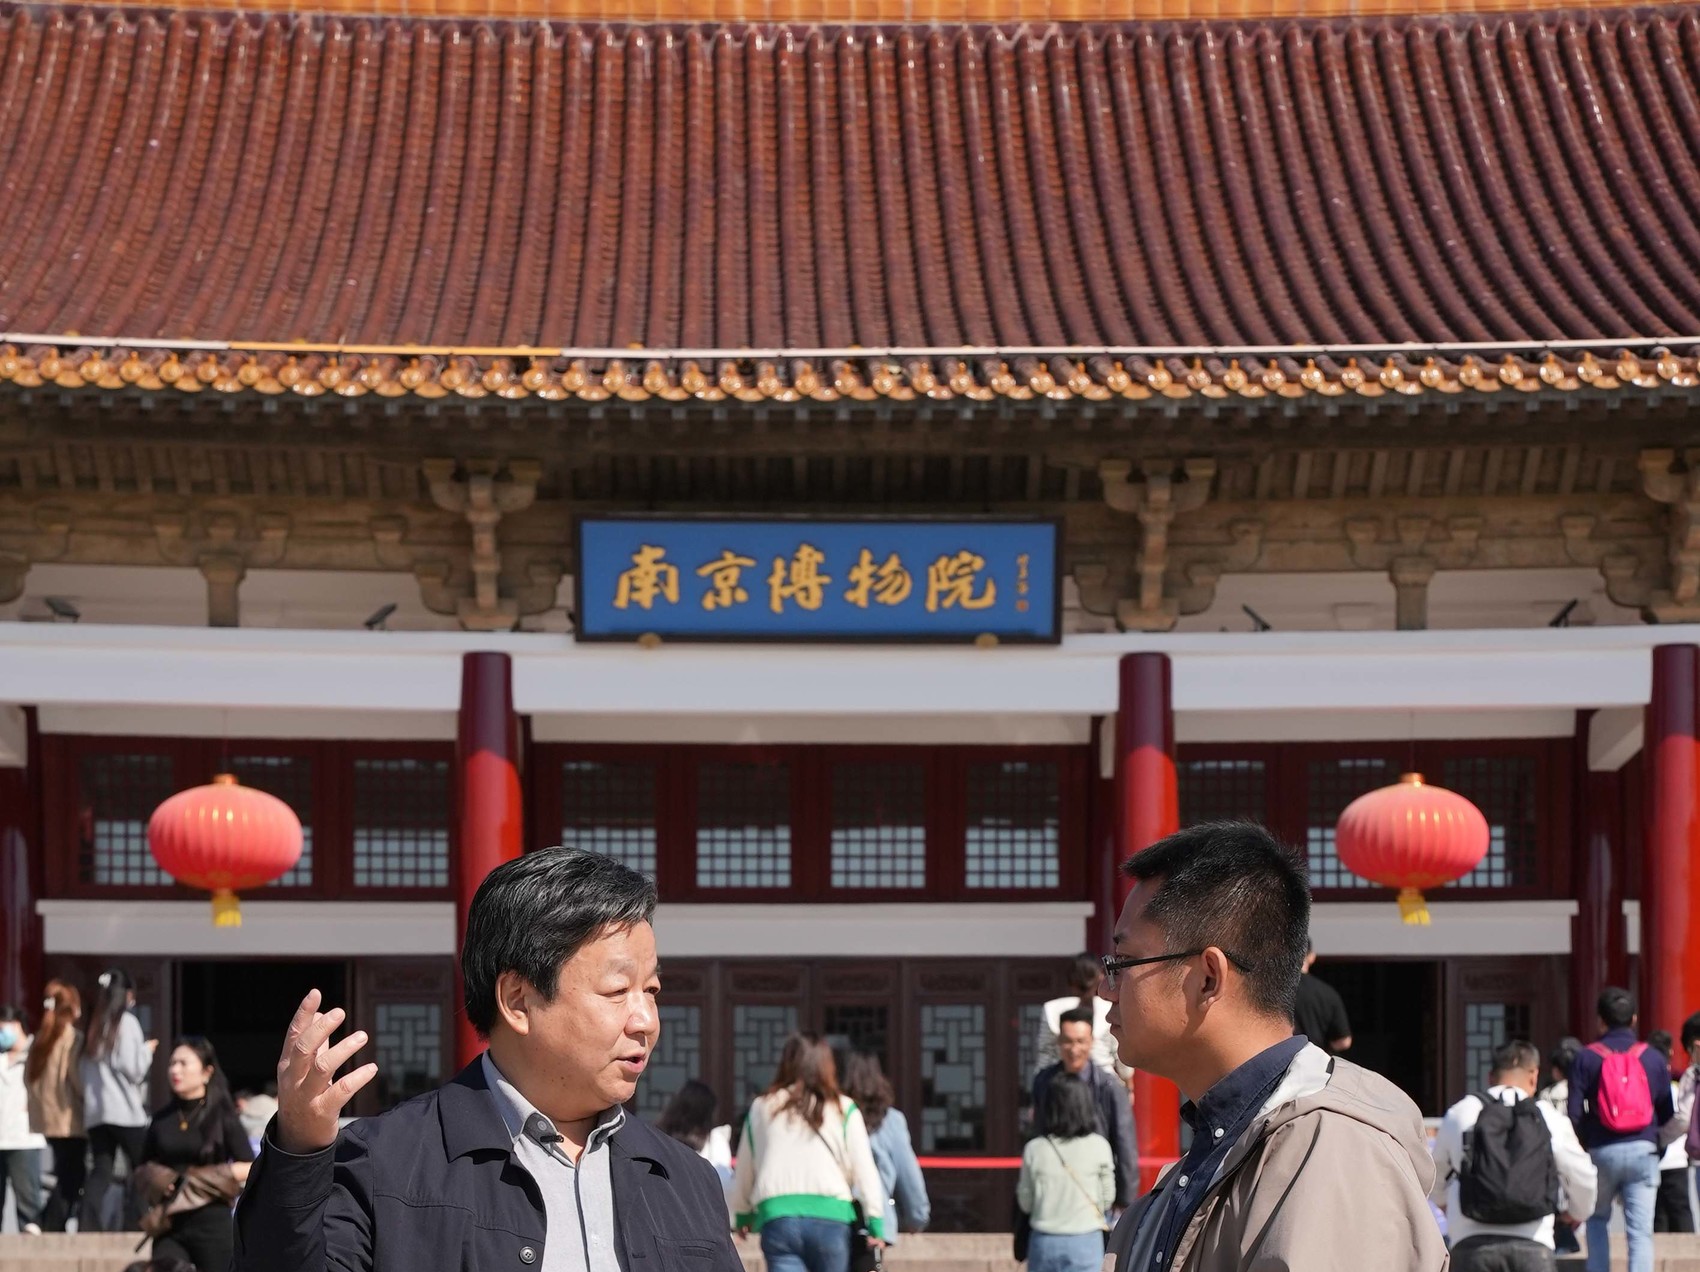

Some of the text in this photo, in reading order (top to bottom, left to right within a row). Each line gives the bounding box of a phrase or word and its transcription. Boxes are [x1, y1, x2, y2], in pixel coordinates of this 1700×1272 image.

[613, 543, 997, 613] 南京博物院
